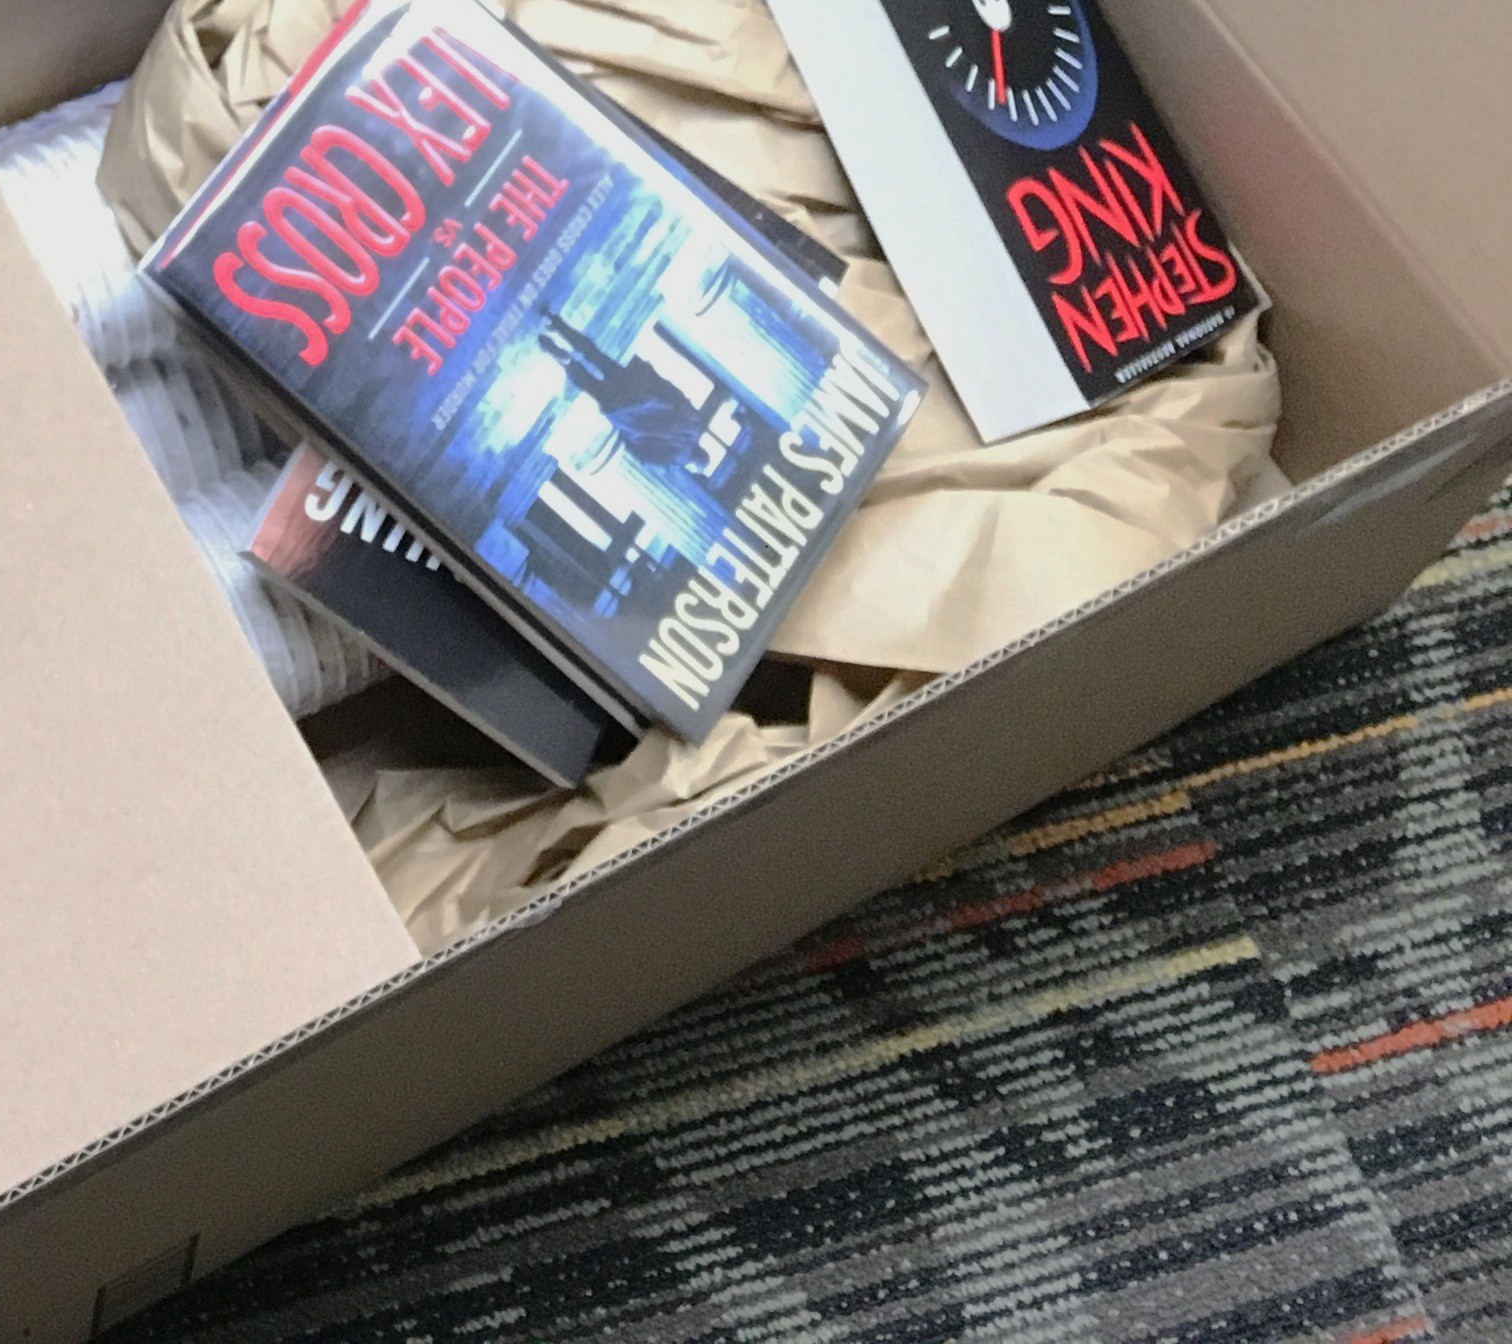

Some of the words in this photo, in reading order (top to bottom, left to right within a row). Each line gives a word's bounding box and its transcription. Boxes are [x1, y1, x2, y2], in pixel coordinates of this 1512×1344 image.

[212, 124, 426, 368] CROSS
[488, 154, 570, 242] THE
[1005, 120, 1187, 288] KING
[392, 221, 518, 377] PEOPLE
[1053, 210, 1238, 373] STEPHEN
[778, 352, 901, 496] JAMES
[638, 462, 825, 713] PATTERSON
